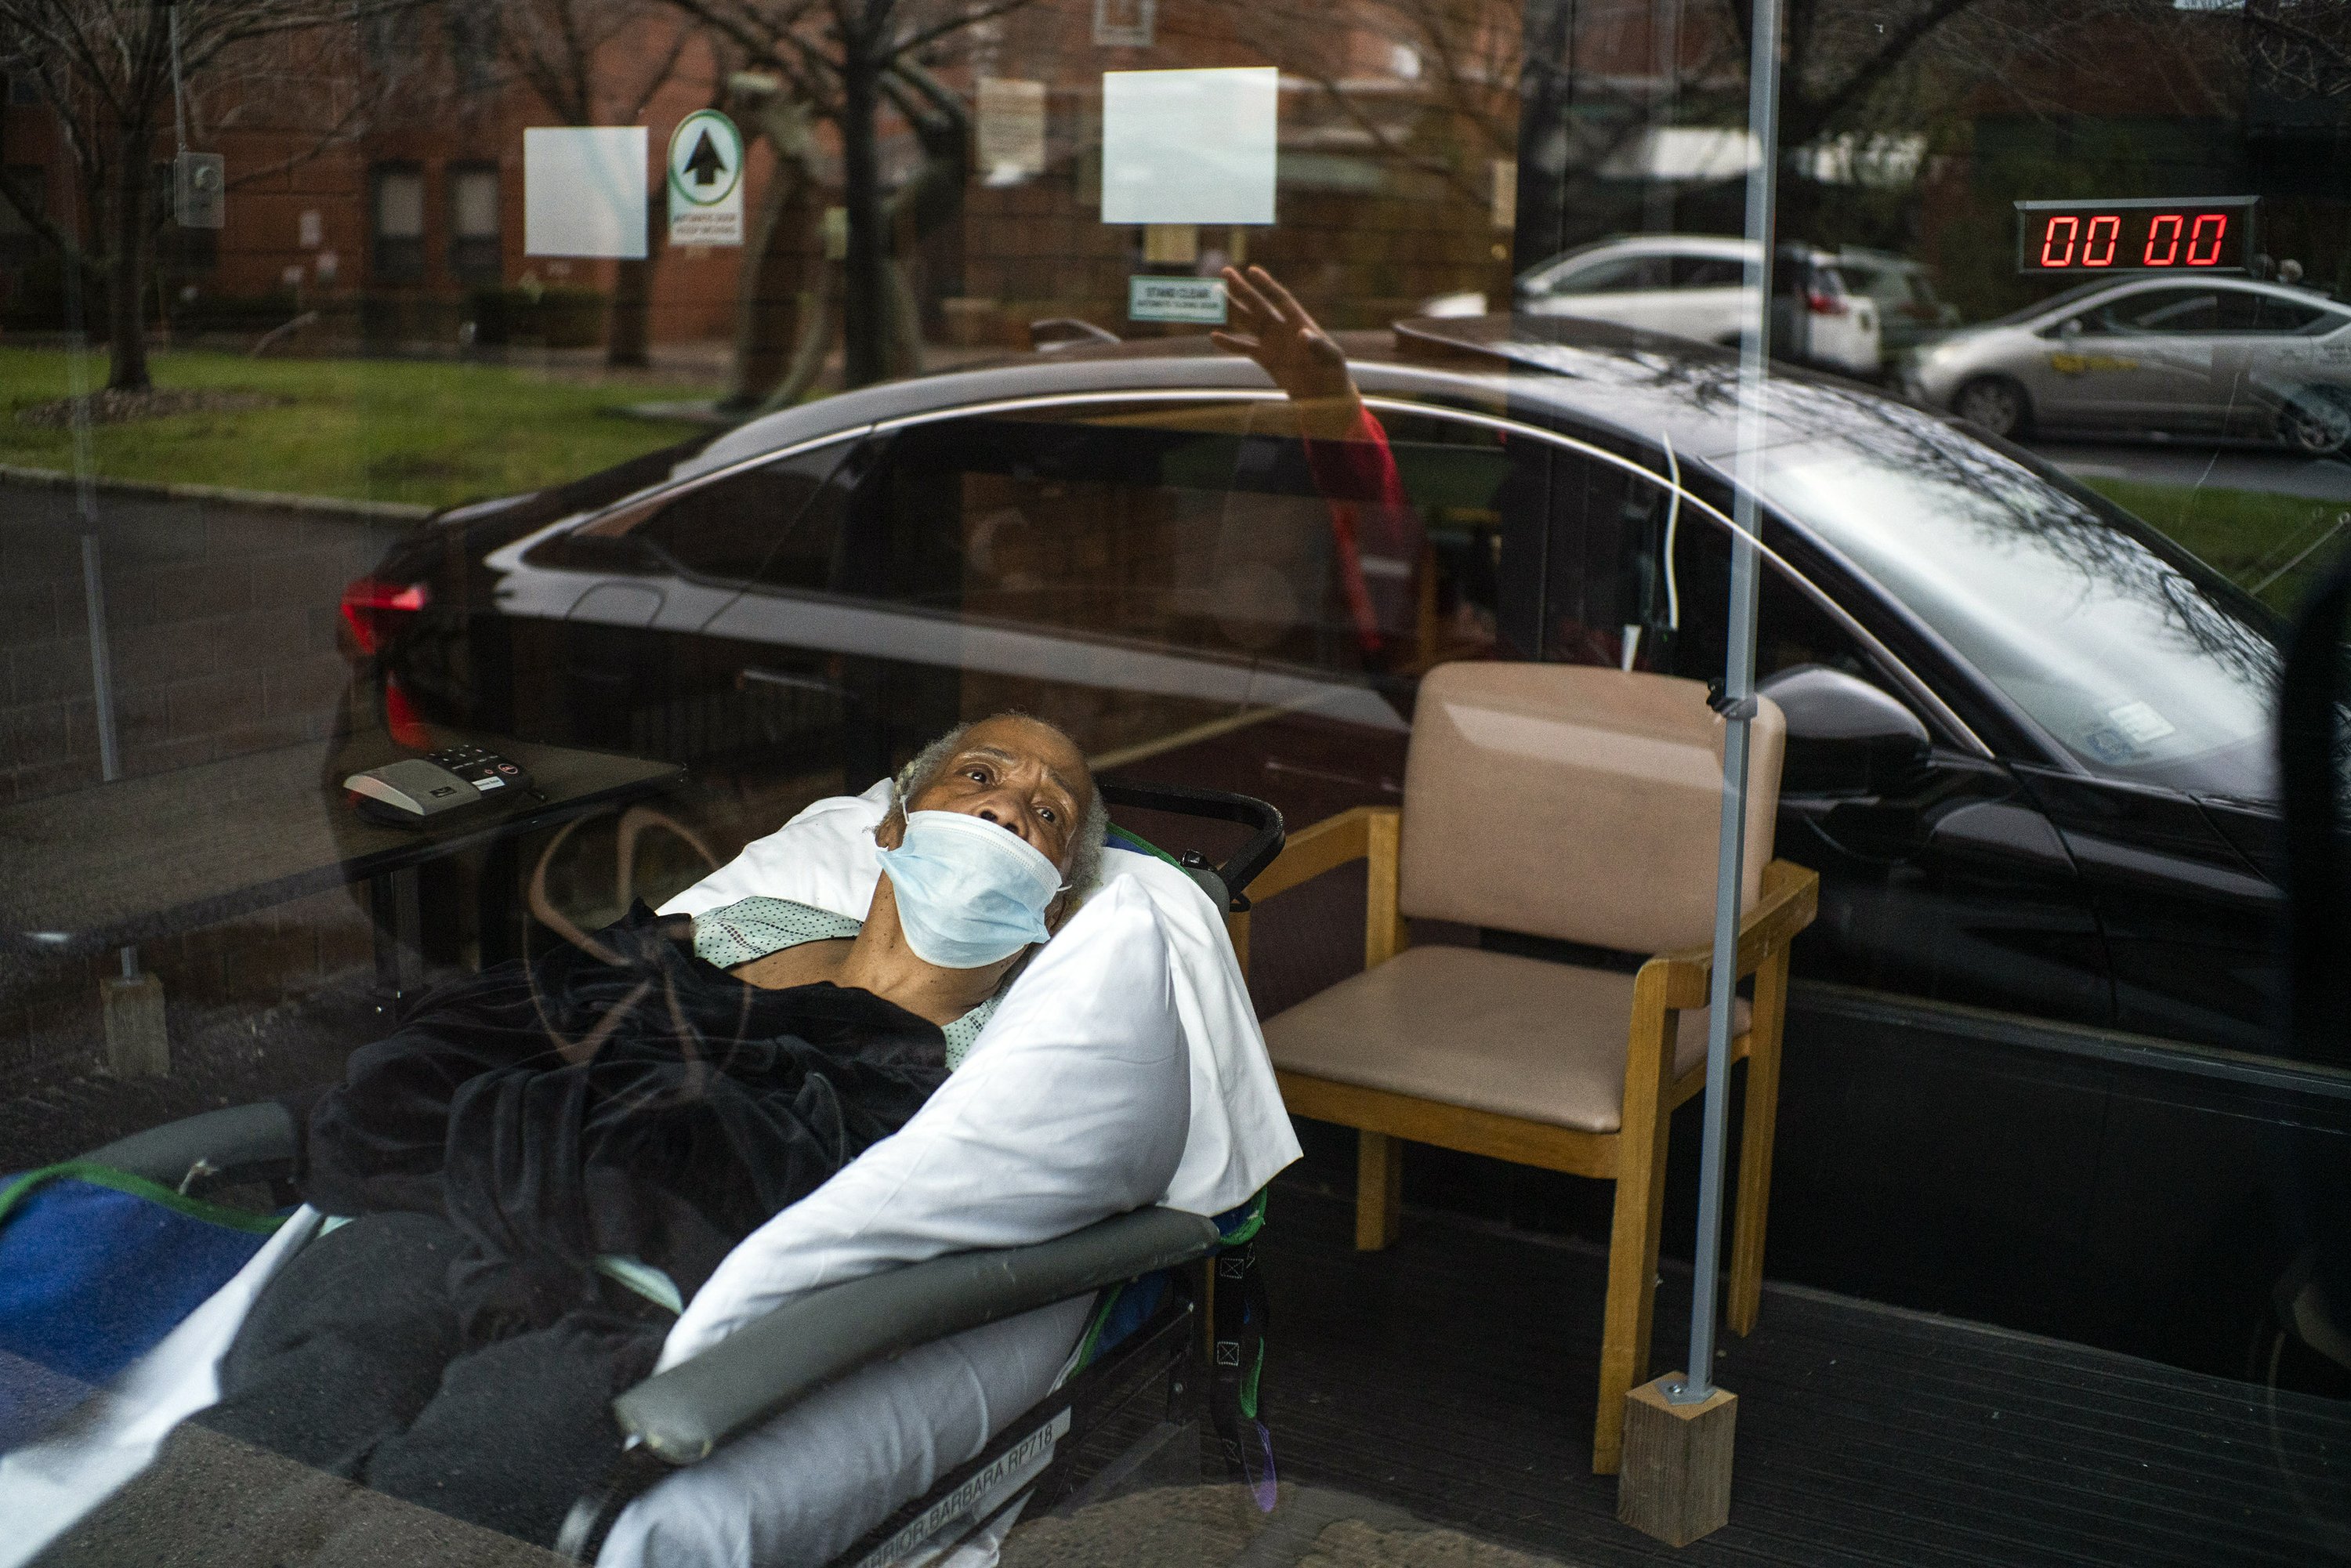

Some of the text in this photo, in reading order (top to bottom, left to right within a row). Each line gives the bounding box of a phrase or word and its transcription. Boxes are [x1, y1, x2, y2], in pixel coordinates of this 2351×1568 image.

[2041, 214, 2227, 266] 00 00
[1008, 1424, 1052, 1472] RP718
